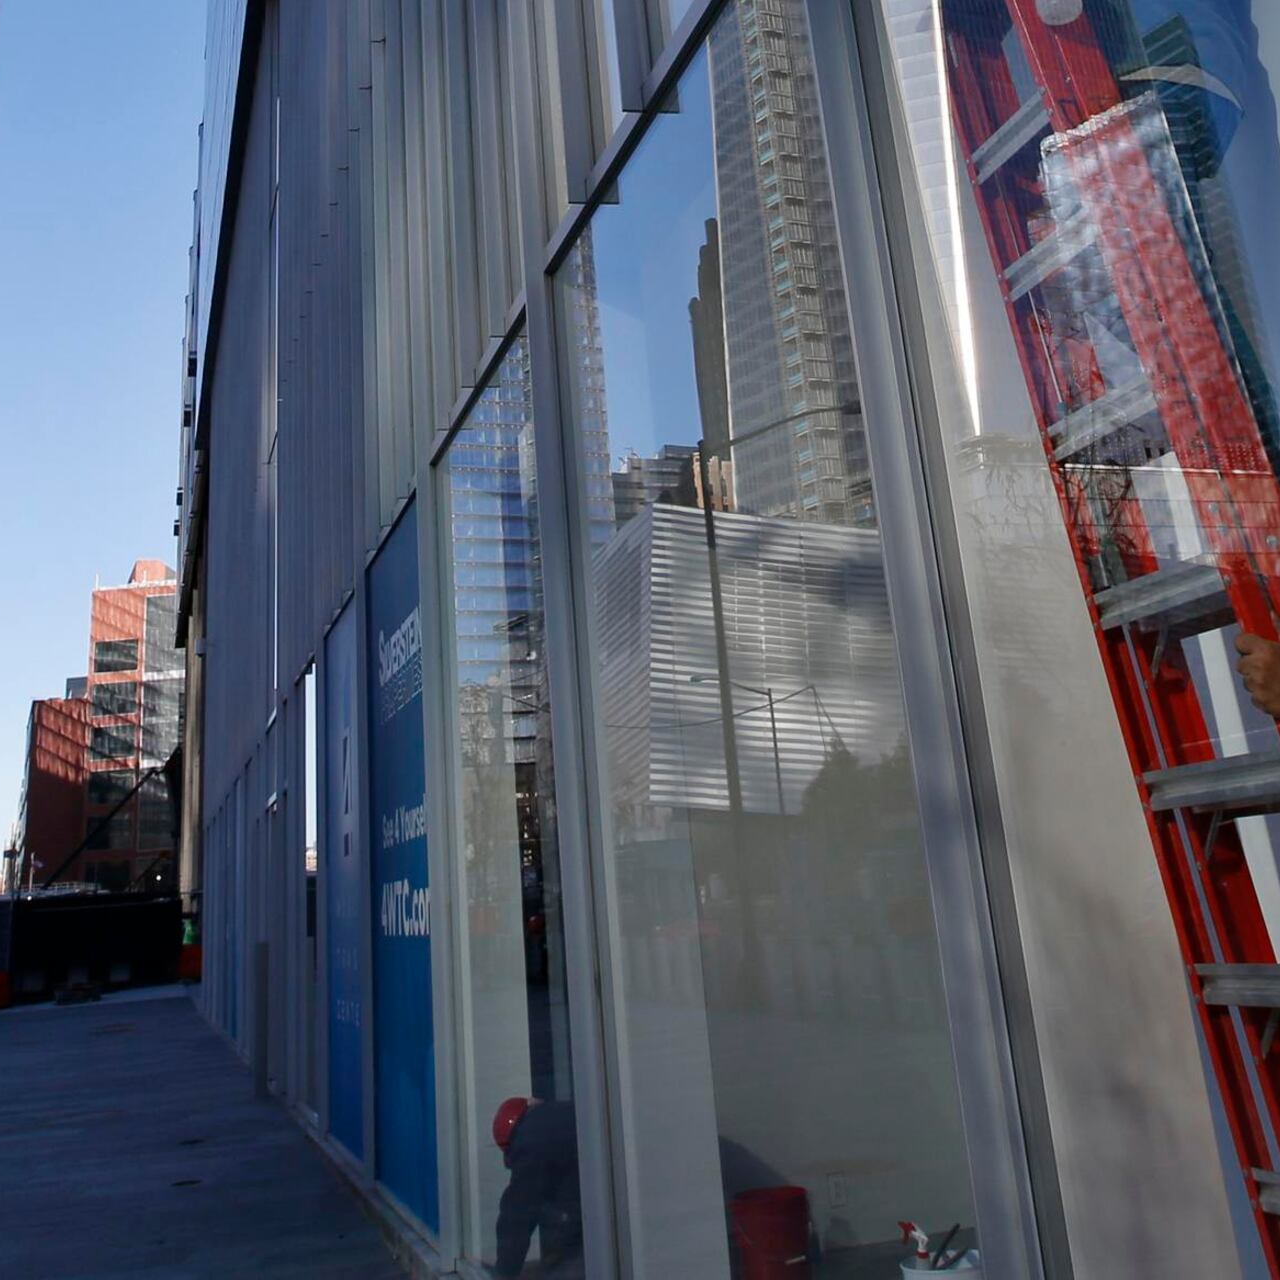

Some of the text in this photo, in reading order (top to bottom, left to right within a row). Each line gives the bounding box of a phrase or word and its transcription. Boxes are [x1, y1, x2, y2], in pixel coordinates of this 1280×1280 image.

[383, 794, 426, 849] See 4 Yoursel
